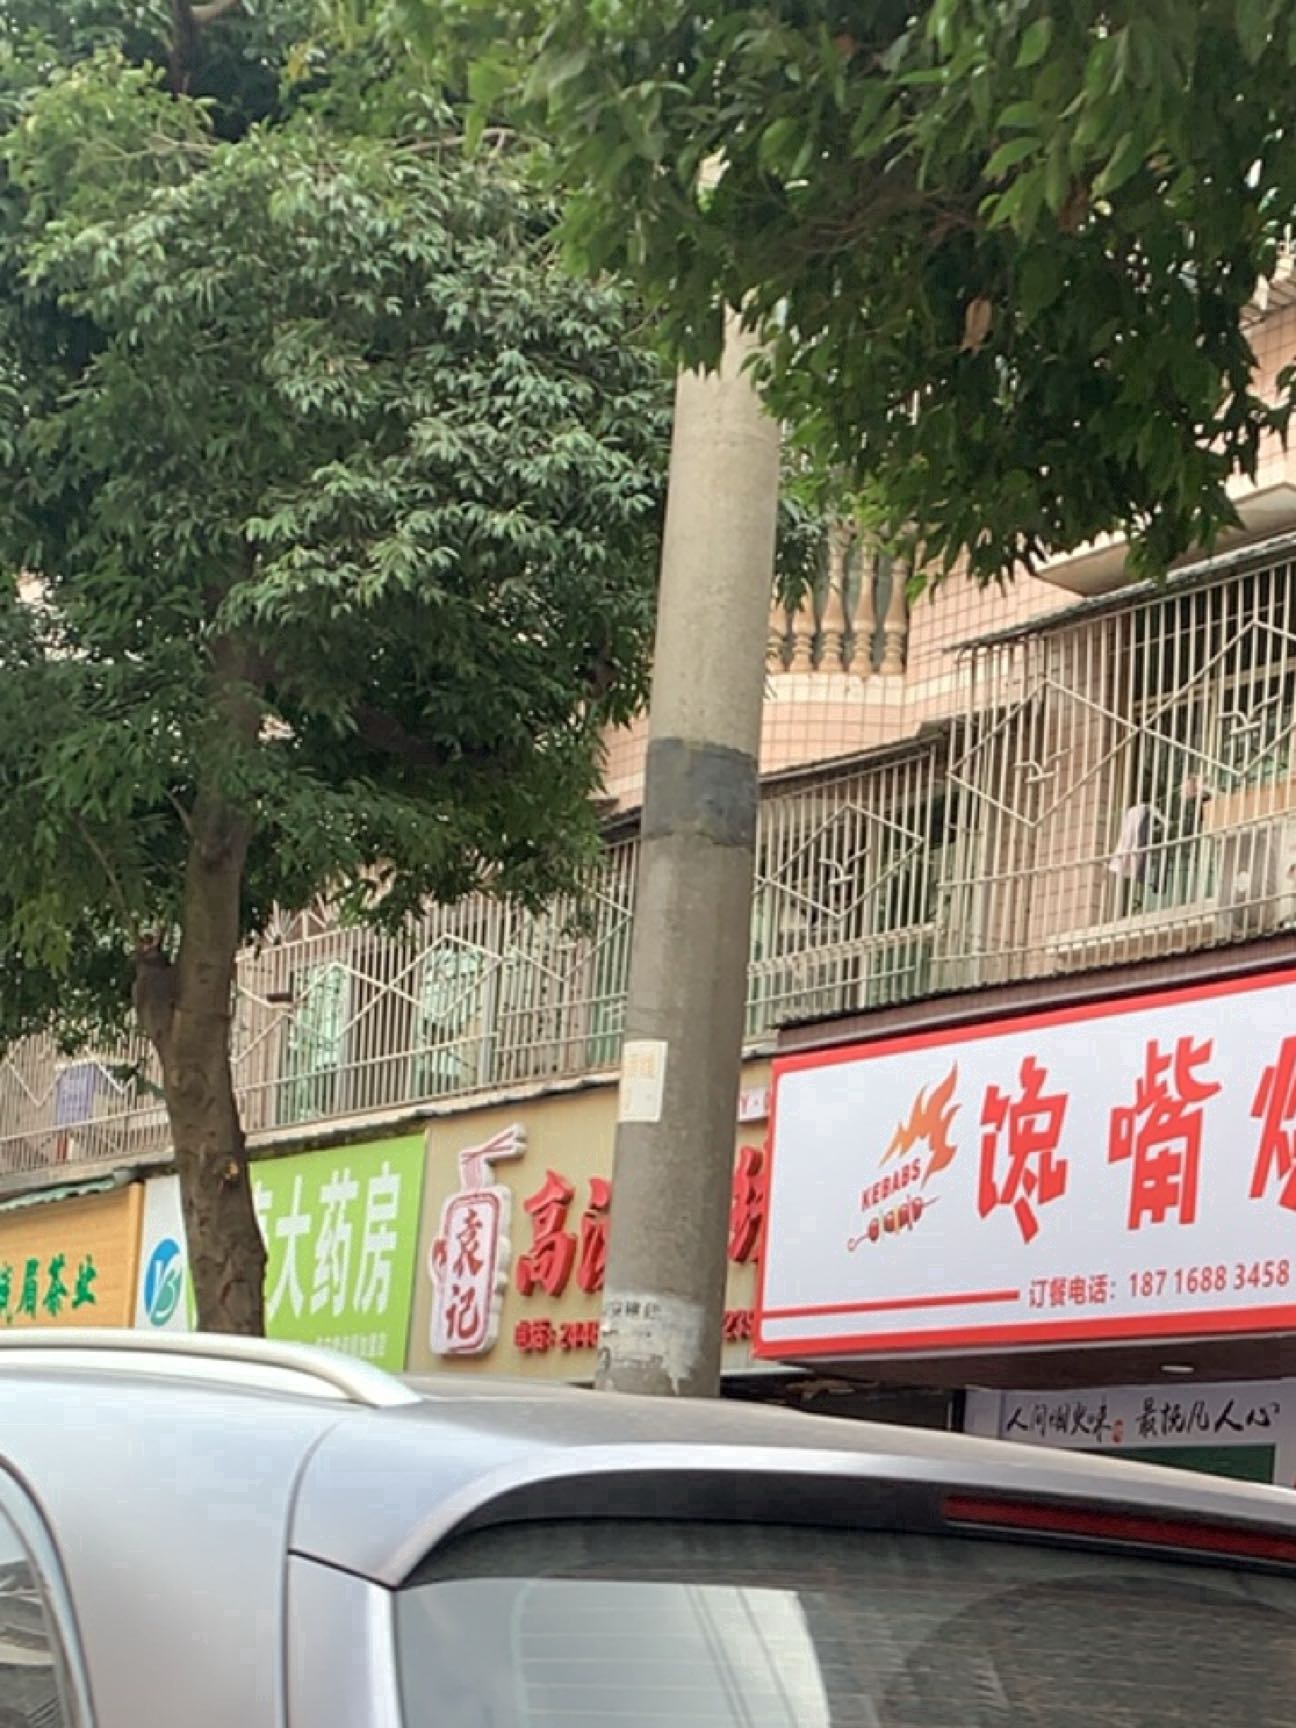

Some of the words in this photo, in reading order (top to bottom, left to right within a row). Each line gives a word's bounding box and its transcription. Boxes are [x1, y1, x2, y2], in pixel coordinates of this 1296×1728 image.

[860, 1158, 922, 1212] KEBABS
[252, 1161, 401, 1323] 大药房
